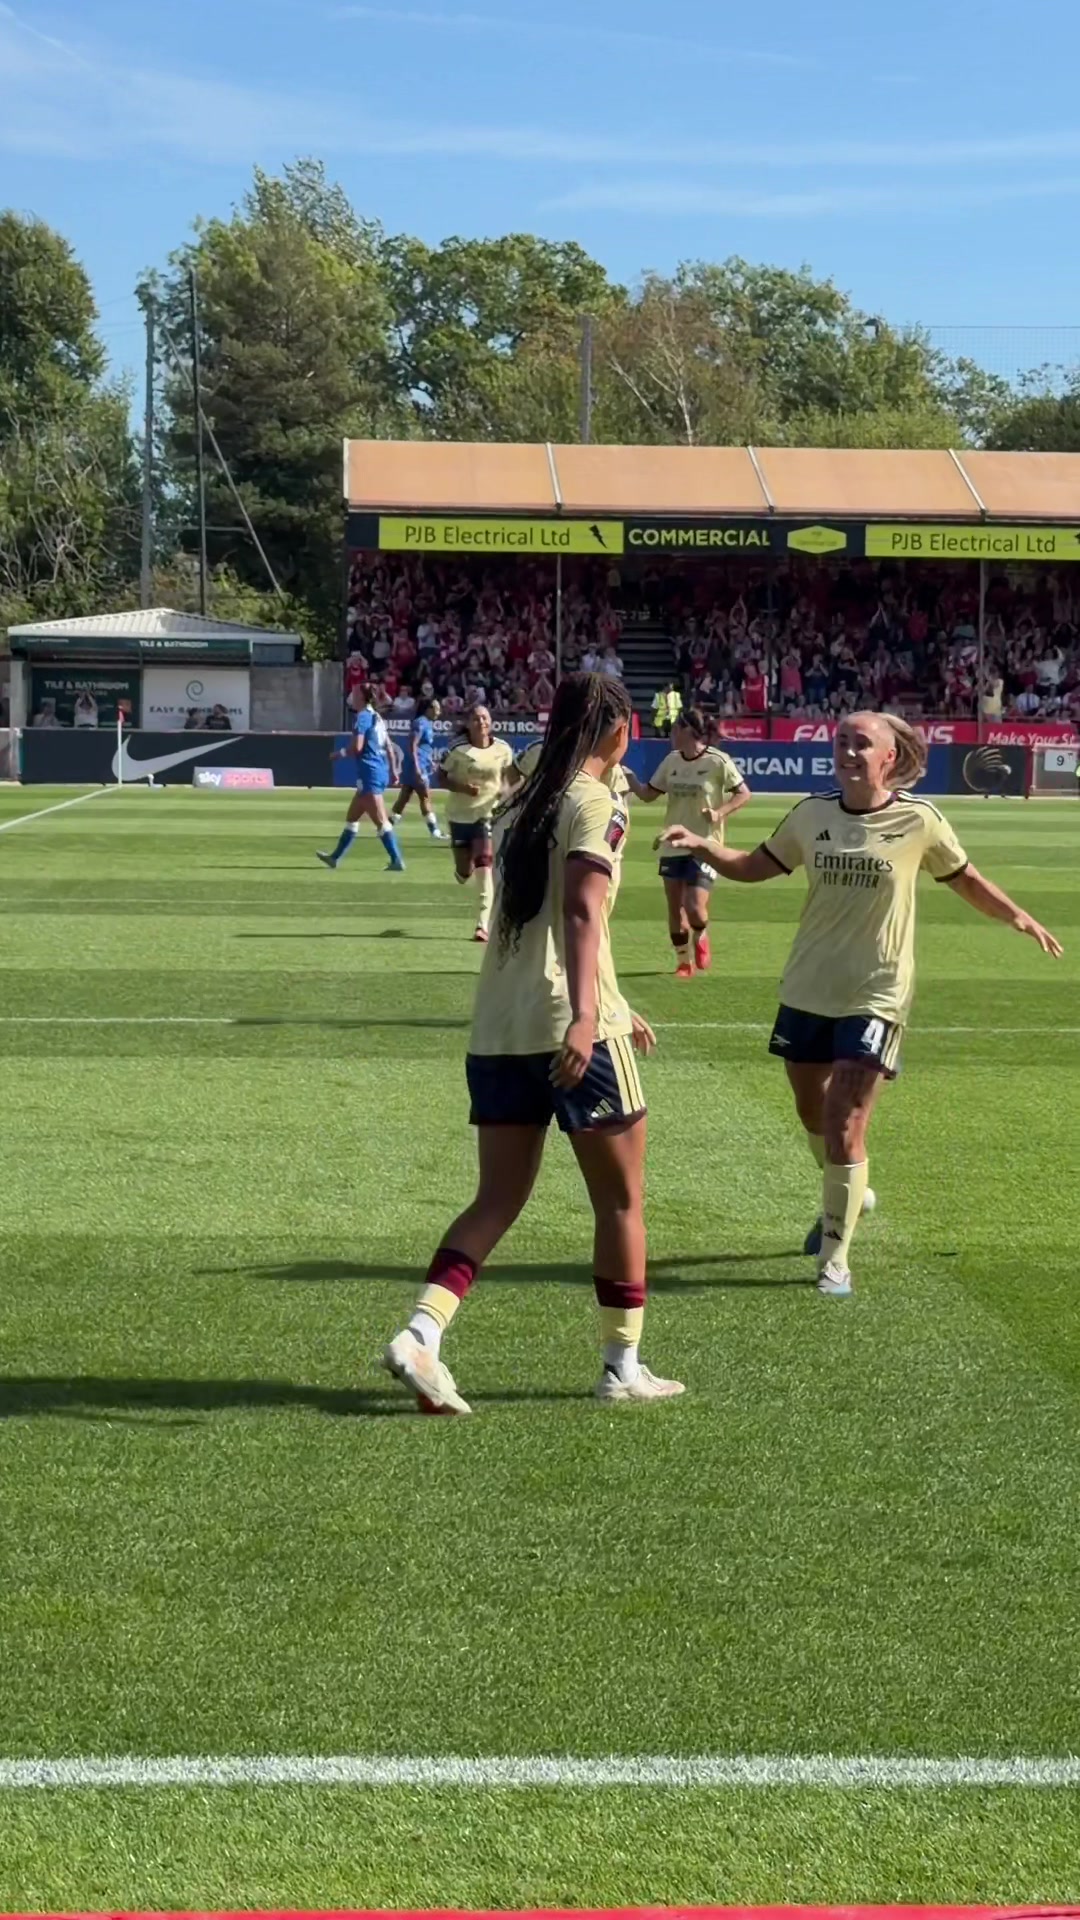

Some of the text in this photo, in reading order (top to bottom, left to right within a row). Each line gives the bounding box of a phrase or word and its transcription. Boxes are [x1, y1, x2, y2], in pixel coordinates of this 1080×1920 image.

[404, 525, 571, 546] PJB Electrical Ltd
[628, 528, 771, 547] COMMERCIAL
[891, 532, 1056, 553] PJB Electrical Ltd
[986, 731, 1026, 746] Make
[733, 756, 805, 776] RICAN
[1056, 755, 1065, 767] 9
[198, 771, 222, 787] sky
[814, 851, 894, 873] Emirates
[823, 871, 881, 889] FLY BETTER
[861, 1017, 885, 1055] 4
